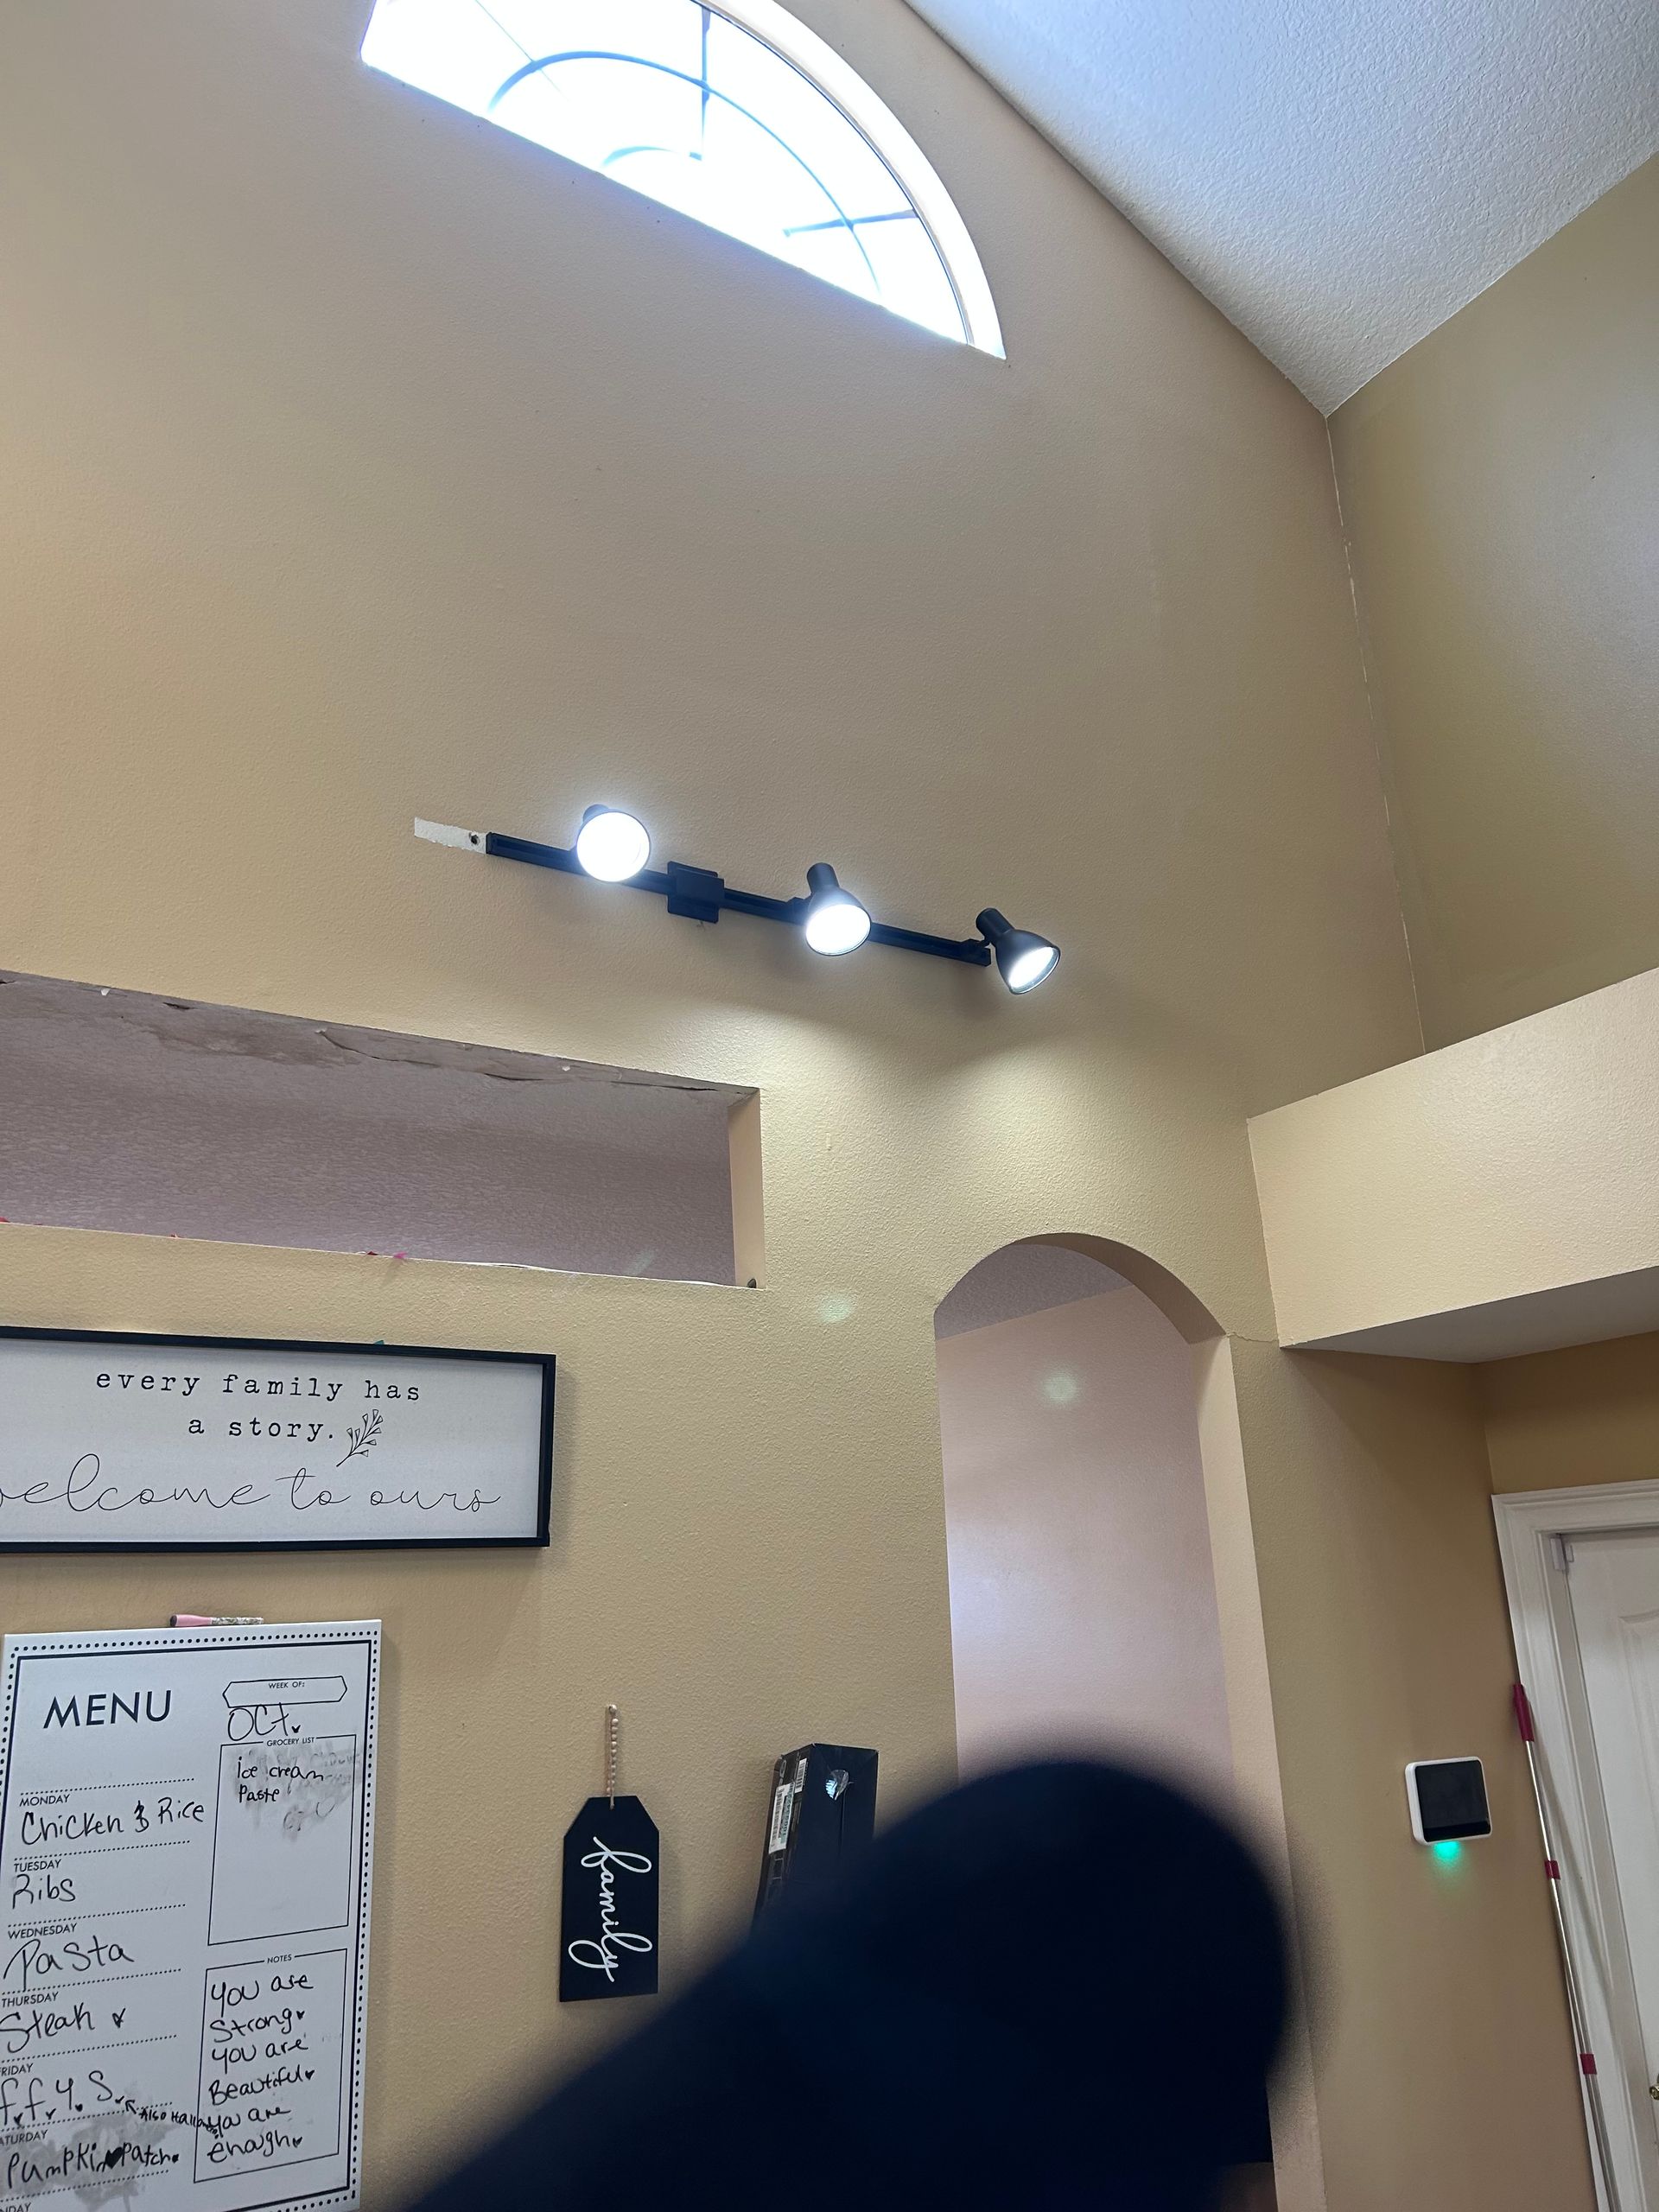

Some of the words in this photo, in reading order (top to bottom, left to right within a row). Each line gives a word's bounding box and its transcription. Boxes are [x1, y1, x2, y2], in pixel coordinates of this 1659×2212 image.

[95, 1370, 200, 1396] every
[221, 1374, 343, 1400] family
[365, 1379, 420, 1402] has
[188, 1416, 205, 1435] a
[227, 1414, 334, 1442] story.
[0, 1452, 271, 1512] elcome
[274, 1466, 352, 1512] to
[370, 1484, 502, 1513] ours
[42, 1689, 172, 1729] MENU
[266, 1738, 300, 1747] GROCERY
[19, 1793, 71, 1808] MONDAY
[13, 1859, 62, 1873] TUESDAY
[567, 1835, 653, 1983] family
[7, 1923, 78, 1939] WEDNESDAY
[266, 1954, 292, 1964] NOTES
[270, 1974, 314, 1992] are
[1, 1991, 59, 2008] THURSDAY
[265, 2037, 308, 2058] are
[0, 2063, 34, 2077] RIDAY
[247, 2106, 291, 2122] are
[0, 2128, 48, 2146] ATURDAY
